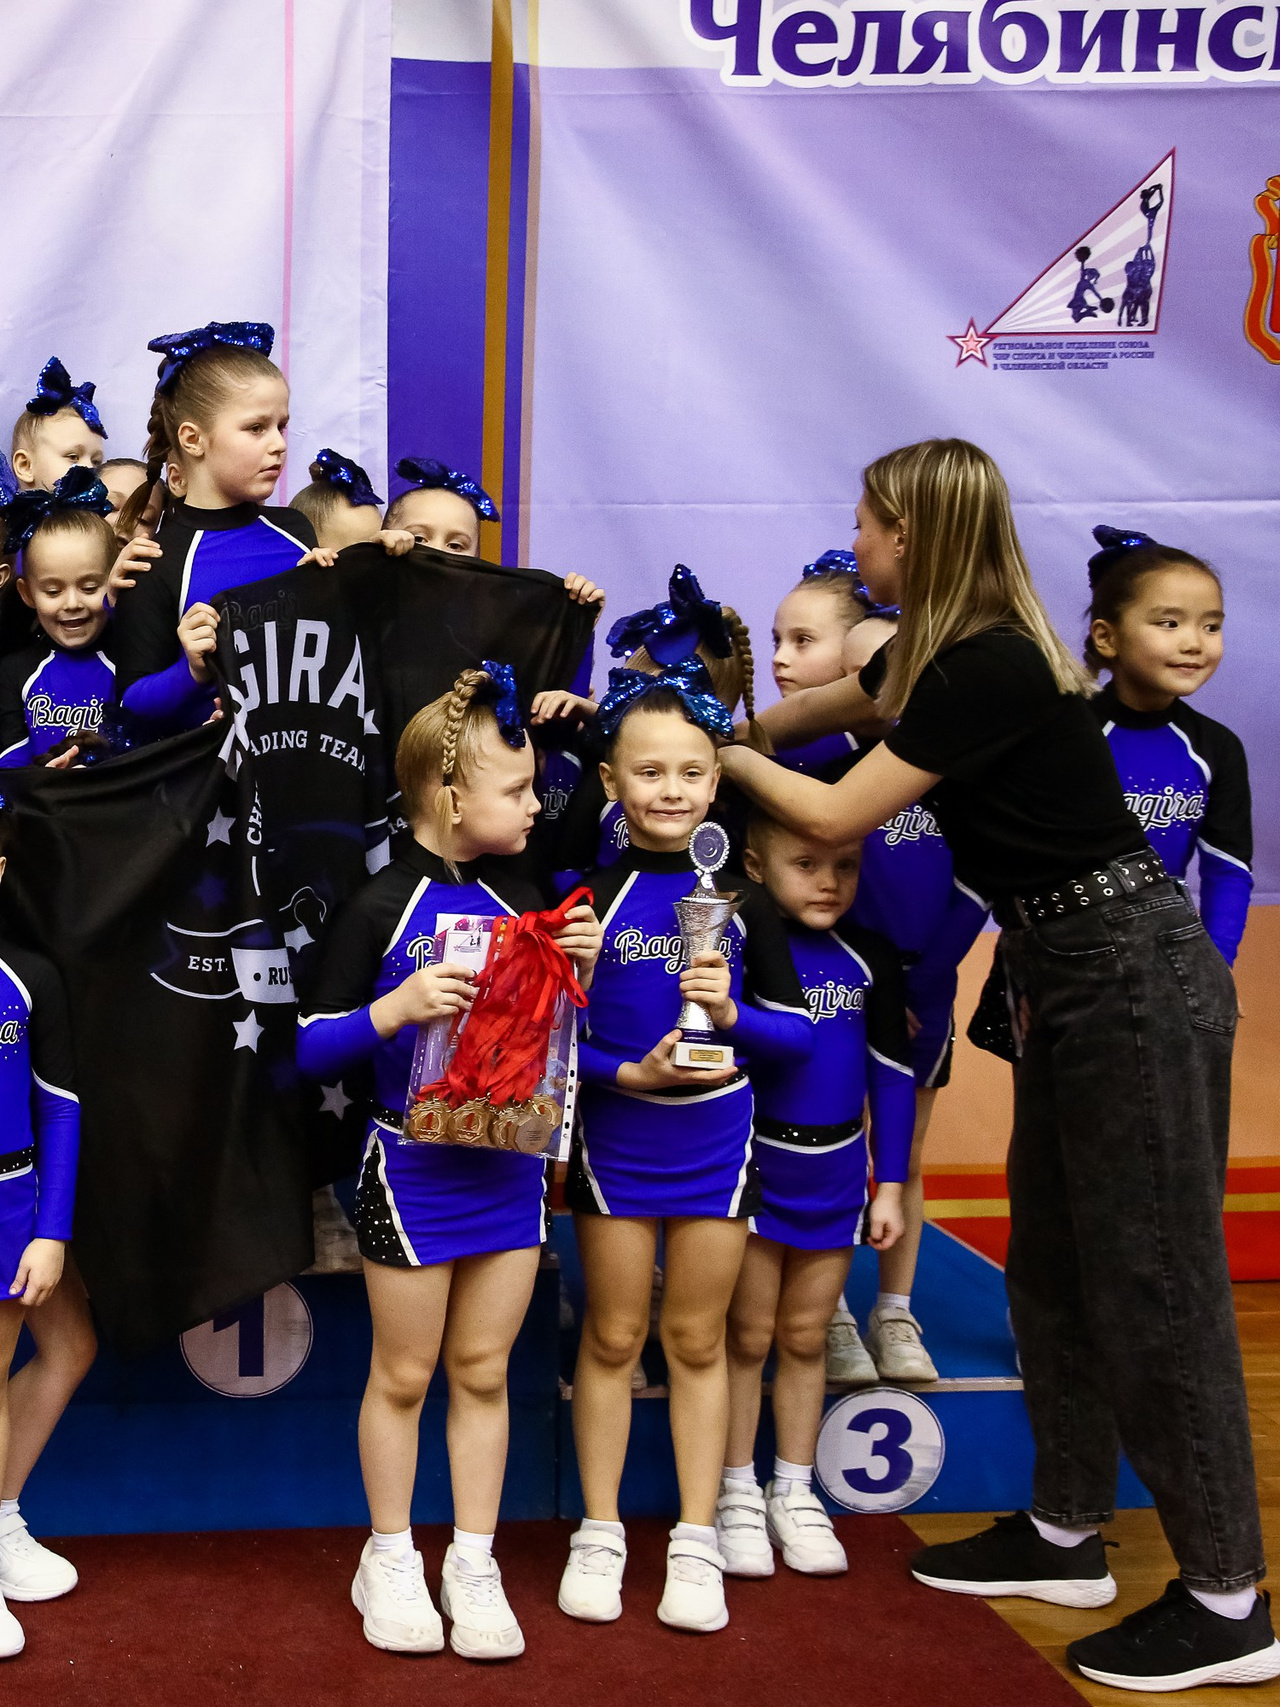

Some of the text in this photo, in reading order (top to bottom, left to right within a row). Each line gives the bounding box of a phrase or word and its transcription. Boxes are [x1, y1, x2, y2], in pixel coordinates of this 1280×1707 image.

[690, 0, 1280, 77] Челябинс
[27, 695, 103, 737] Bagi
[188, 955, 293, 986] EST. RU
[213, 1292, 265, 1377] 1
[842, 1407, 914, 1494] 3
